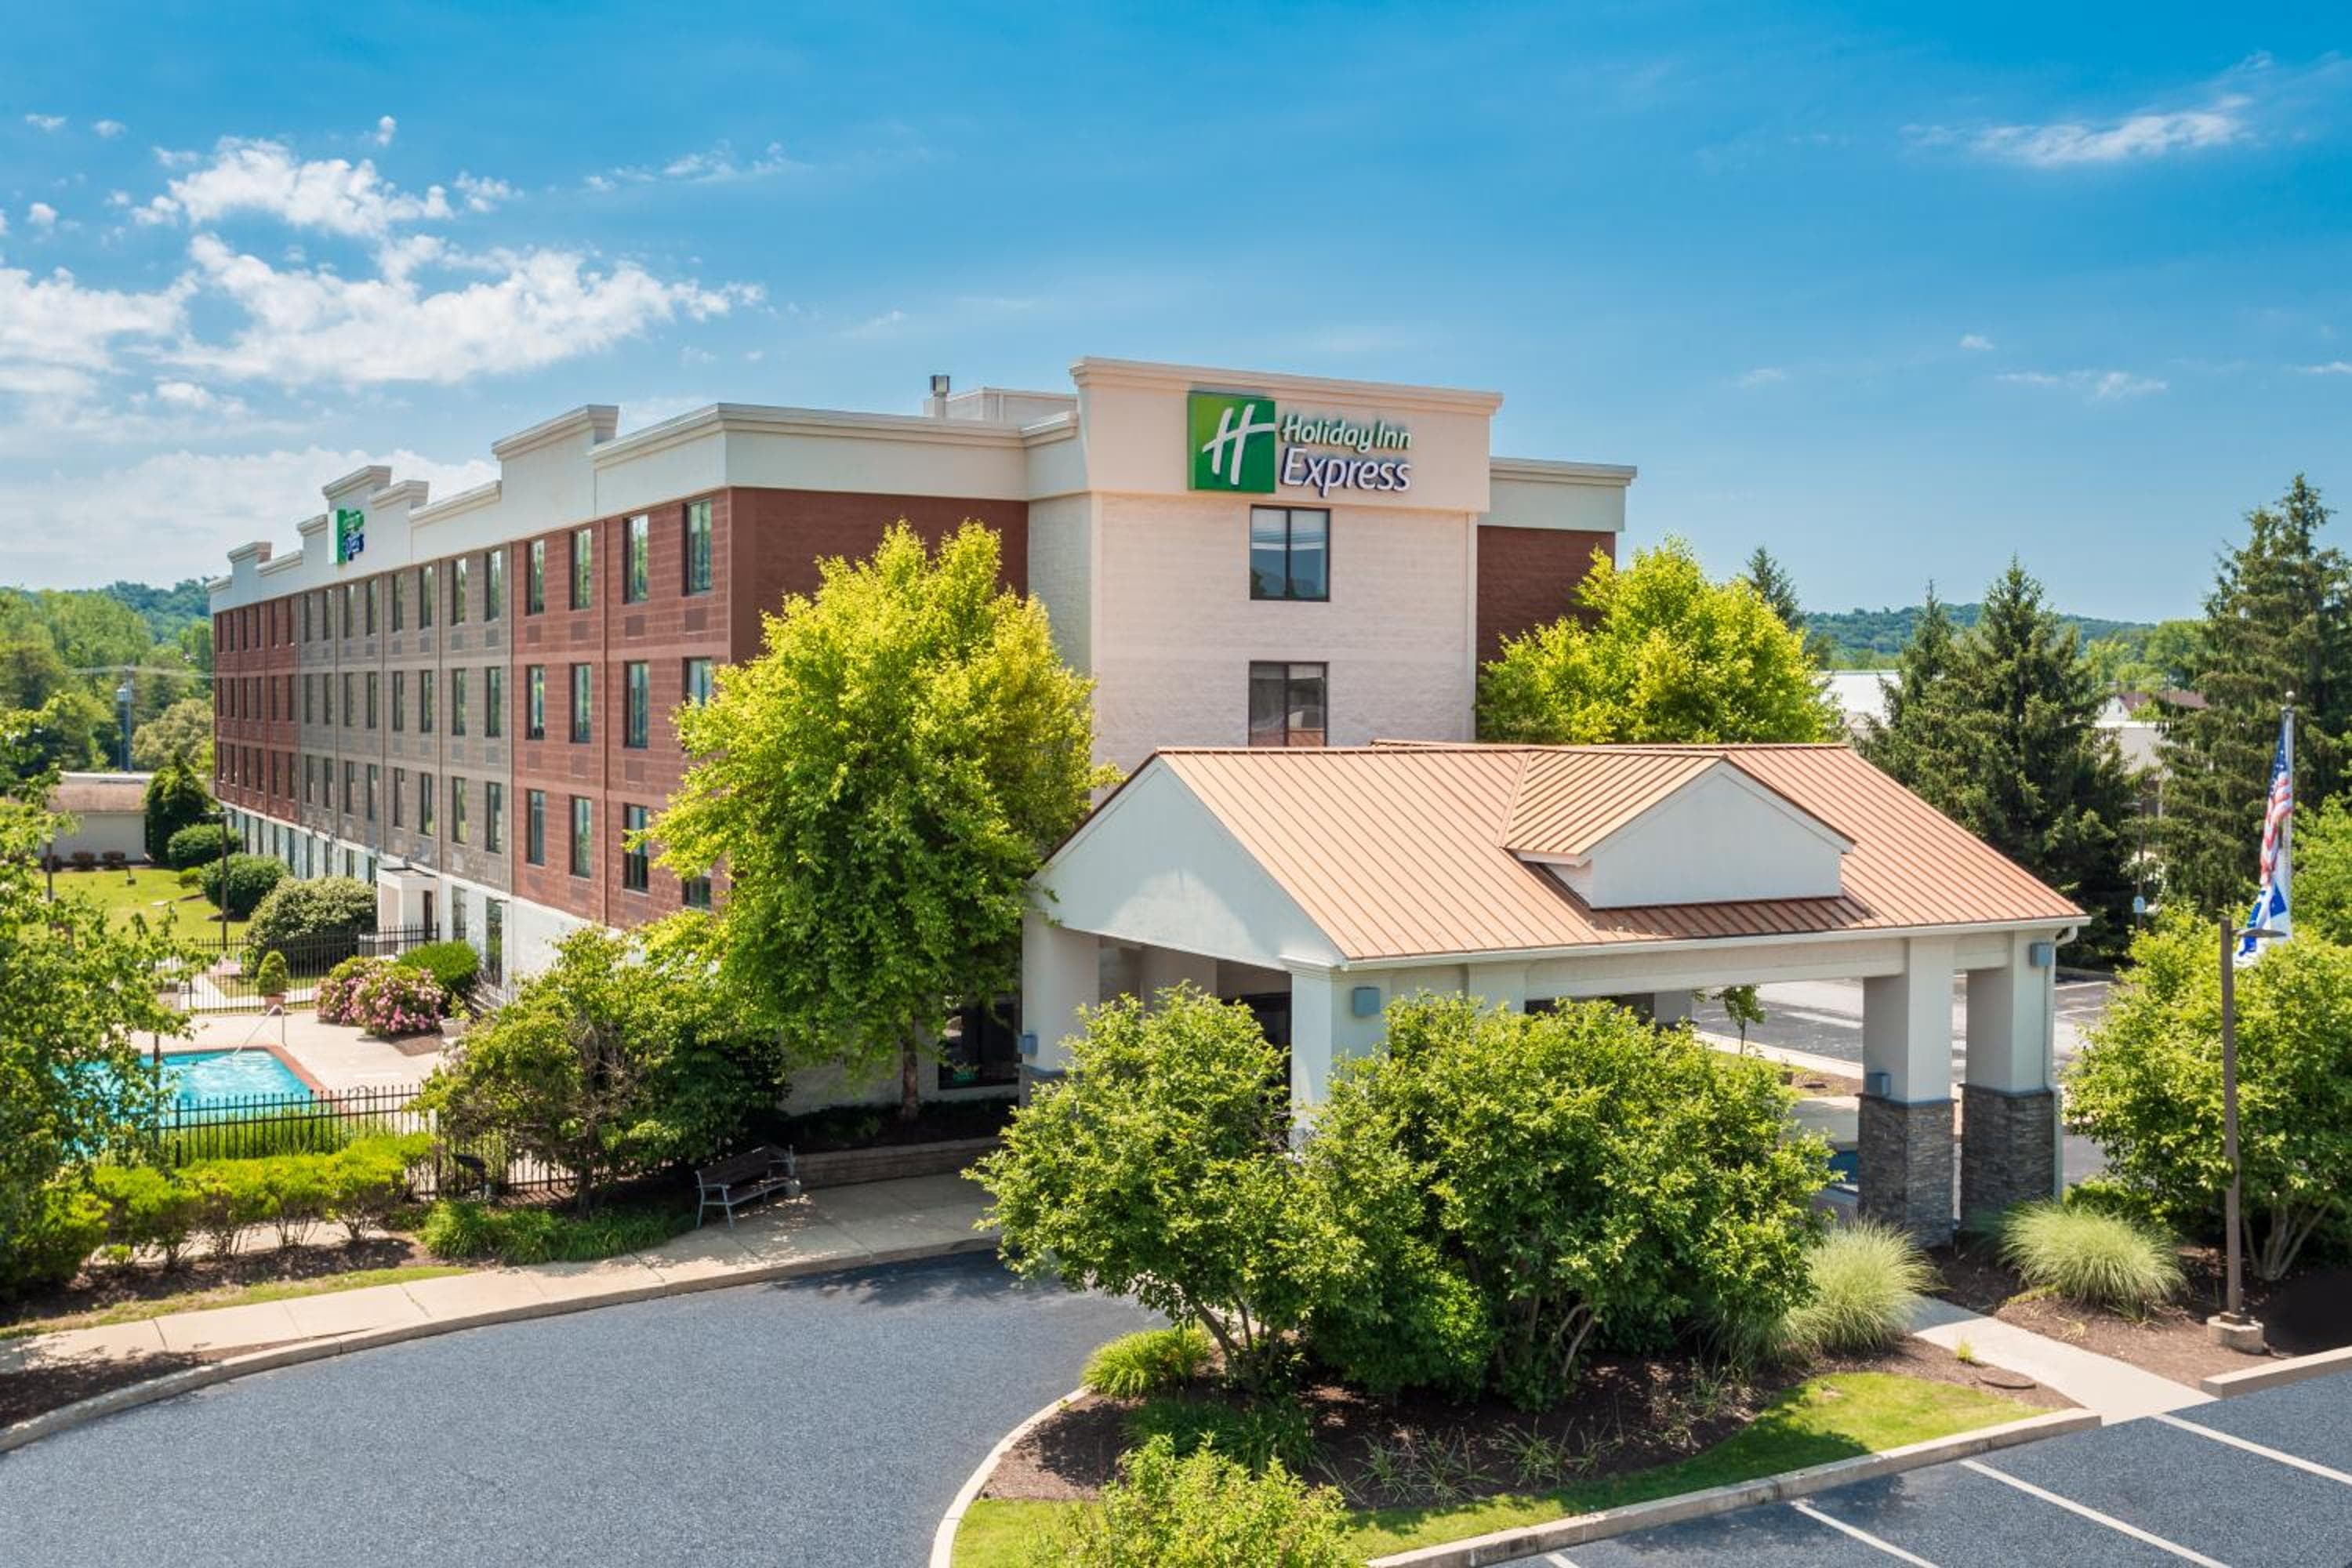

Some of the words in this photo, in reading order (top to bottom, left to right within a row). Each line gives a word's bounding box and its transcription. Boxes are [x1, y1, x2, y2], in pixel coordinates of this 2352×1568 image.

[1281, 414, 1371, 454] Holiday
[1376, 420, 1412, 449] Inn
[1281, 447, 1412, 497] Express
